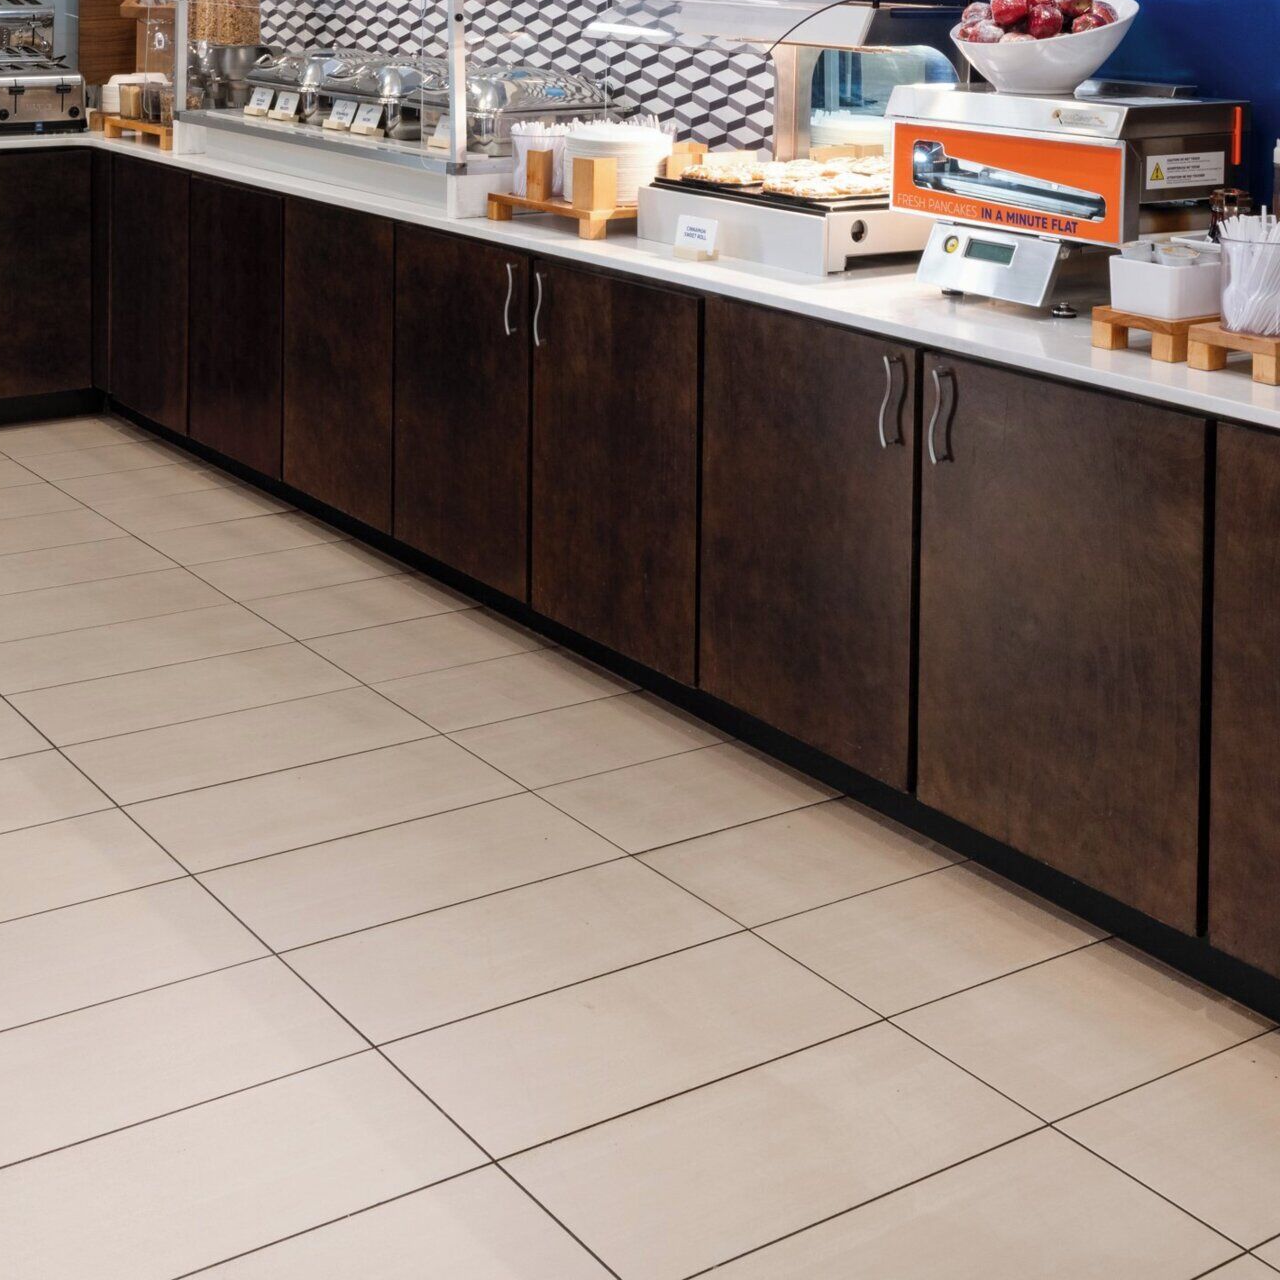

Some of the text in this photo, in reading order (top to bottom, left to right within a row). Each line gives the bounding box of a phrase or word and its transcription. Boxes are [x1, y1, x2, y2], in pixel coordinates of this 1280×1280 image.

[898, 194, 1079, 234] FRESH PANCAKES IN A MINUTE FLAT
